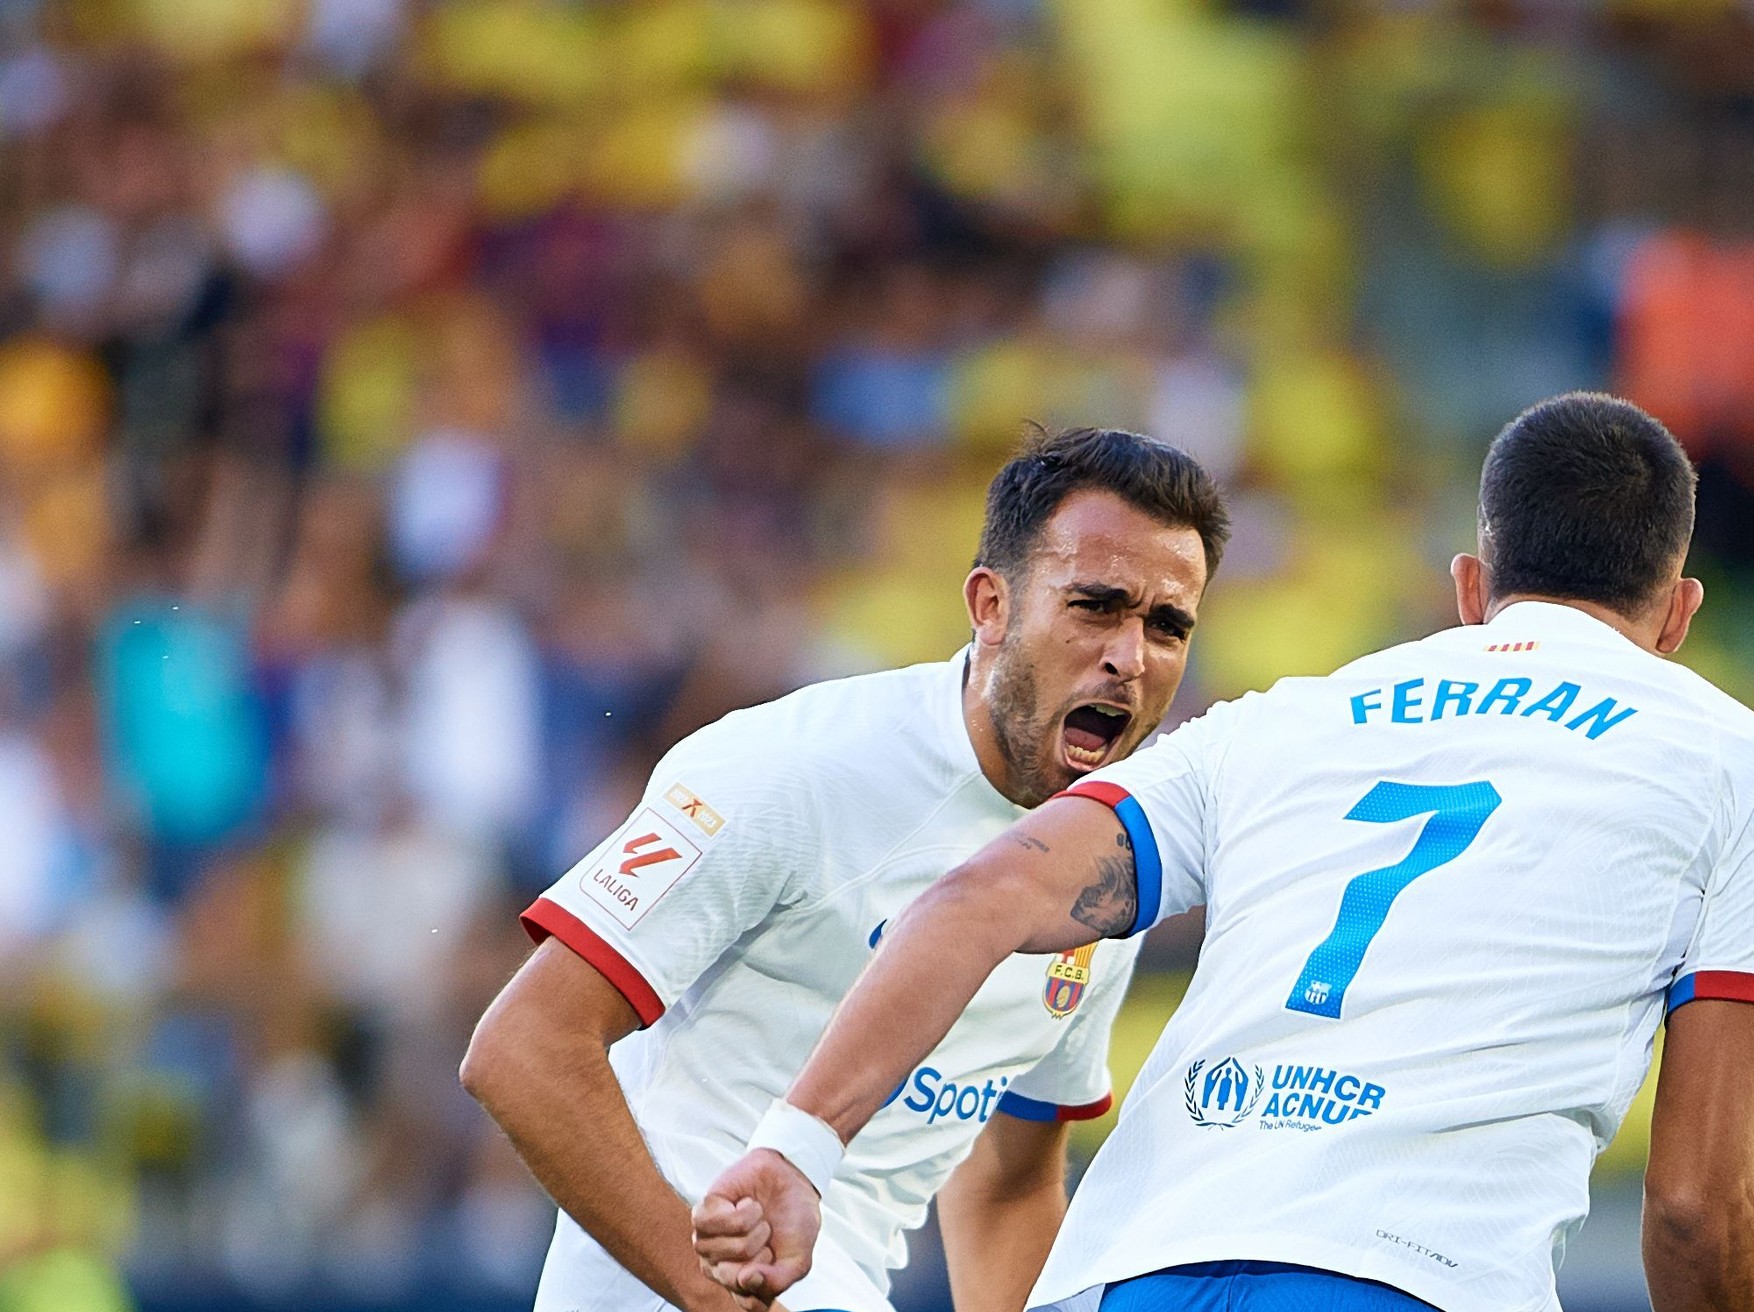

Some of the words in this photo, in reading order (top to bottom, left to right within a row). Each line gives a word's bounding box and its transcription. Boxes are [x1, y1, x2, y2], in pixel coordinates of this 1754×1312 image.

[1350, 677, 1638, 740] FERRAN
[593, 869, 640, 911] LALIGA
[1284, 780, 1502, 1020] 7
[1054, 964, 1084, 980] F.C.B.
[1272, 1065, 1386, 1109] UNHCR
[1260, 1120, 1273, 1130] The
